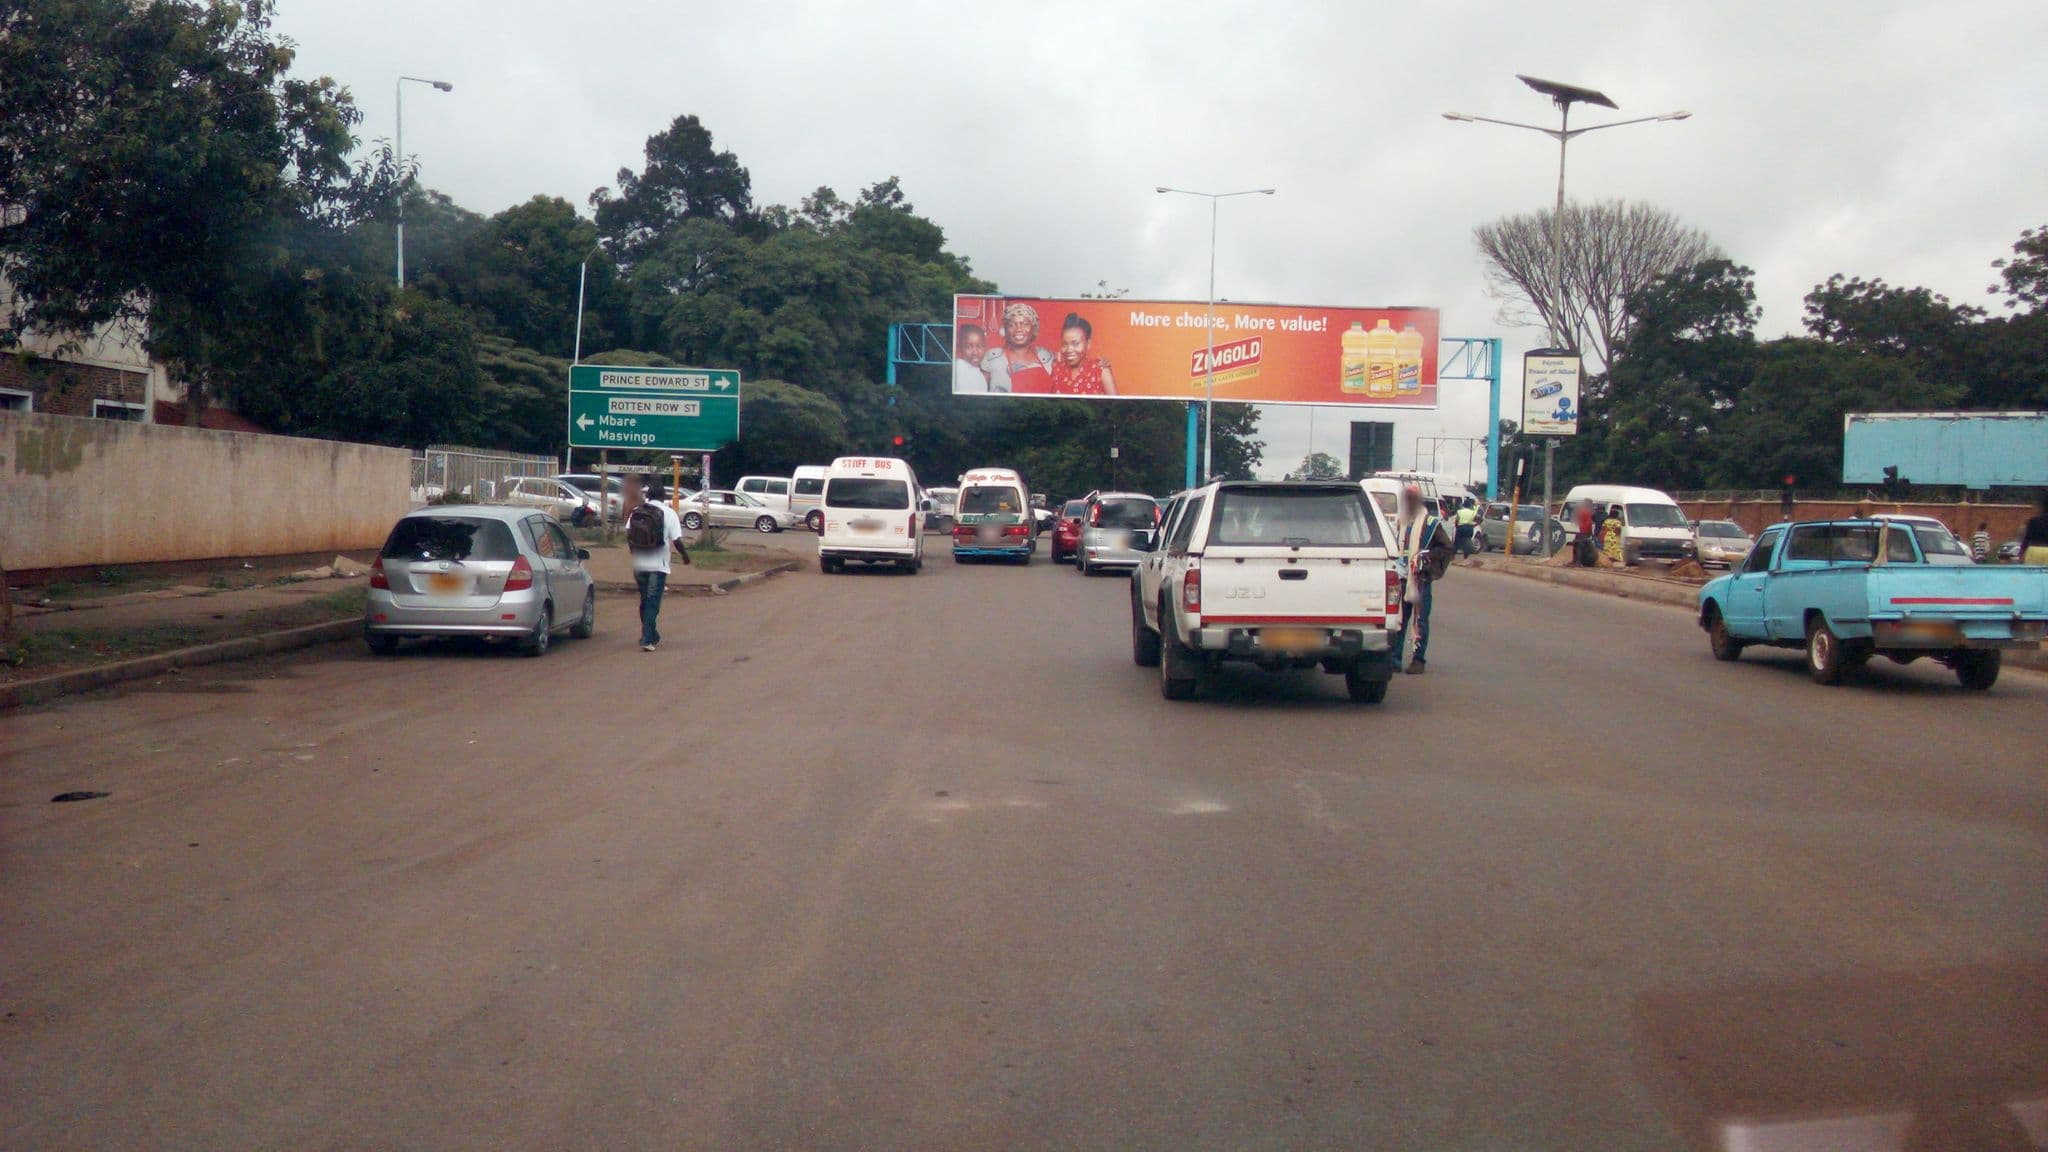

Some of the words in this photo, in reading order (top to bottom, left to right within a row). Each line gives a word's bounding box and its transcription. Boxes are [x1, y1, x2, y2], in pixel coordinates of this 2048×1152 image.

[1130, 312, 1170, 327] More
[1175, 312, 1229, 331] choice,
[1235, 314, 1275, 330] More
[1280, 315, 1327, 332] value!
[1192, 341, 1260, 373] ZIMGOLD
[602, 375, 640, 385] PRINCE
[645, 376, 689, 386] EDWARD
[694, 377, 707, 387] ST
[611, 400, 650, 411] ROTTEN
[656, 402, 678, 412] ROW
[684, 403, 697, 413] ST
[599, 415, 636, 427] Mbare
[599, 430, 656, 445] Masvingo
[875, 460, 891, 469] BUS
